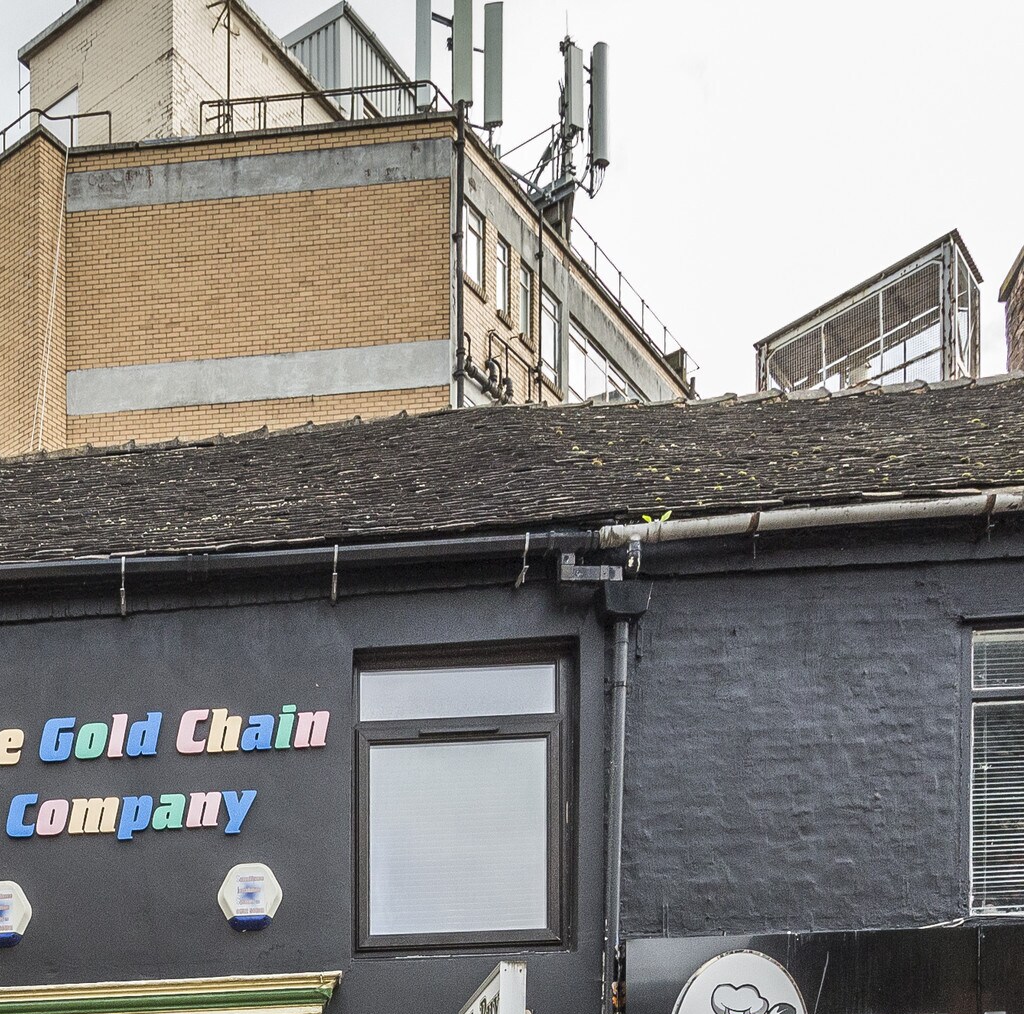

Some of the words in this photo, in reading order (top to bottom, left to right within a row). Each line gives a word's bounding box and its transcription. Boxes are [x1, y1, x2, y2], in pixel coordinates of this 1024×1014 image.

[38, 711, 163, 763] Gold
[175, 704, 330, 754] Chain
[5, 789, 258, 841] Company
